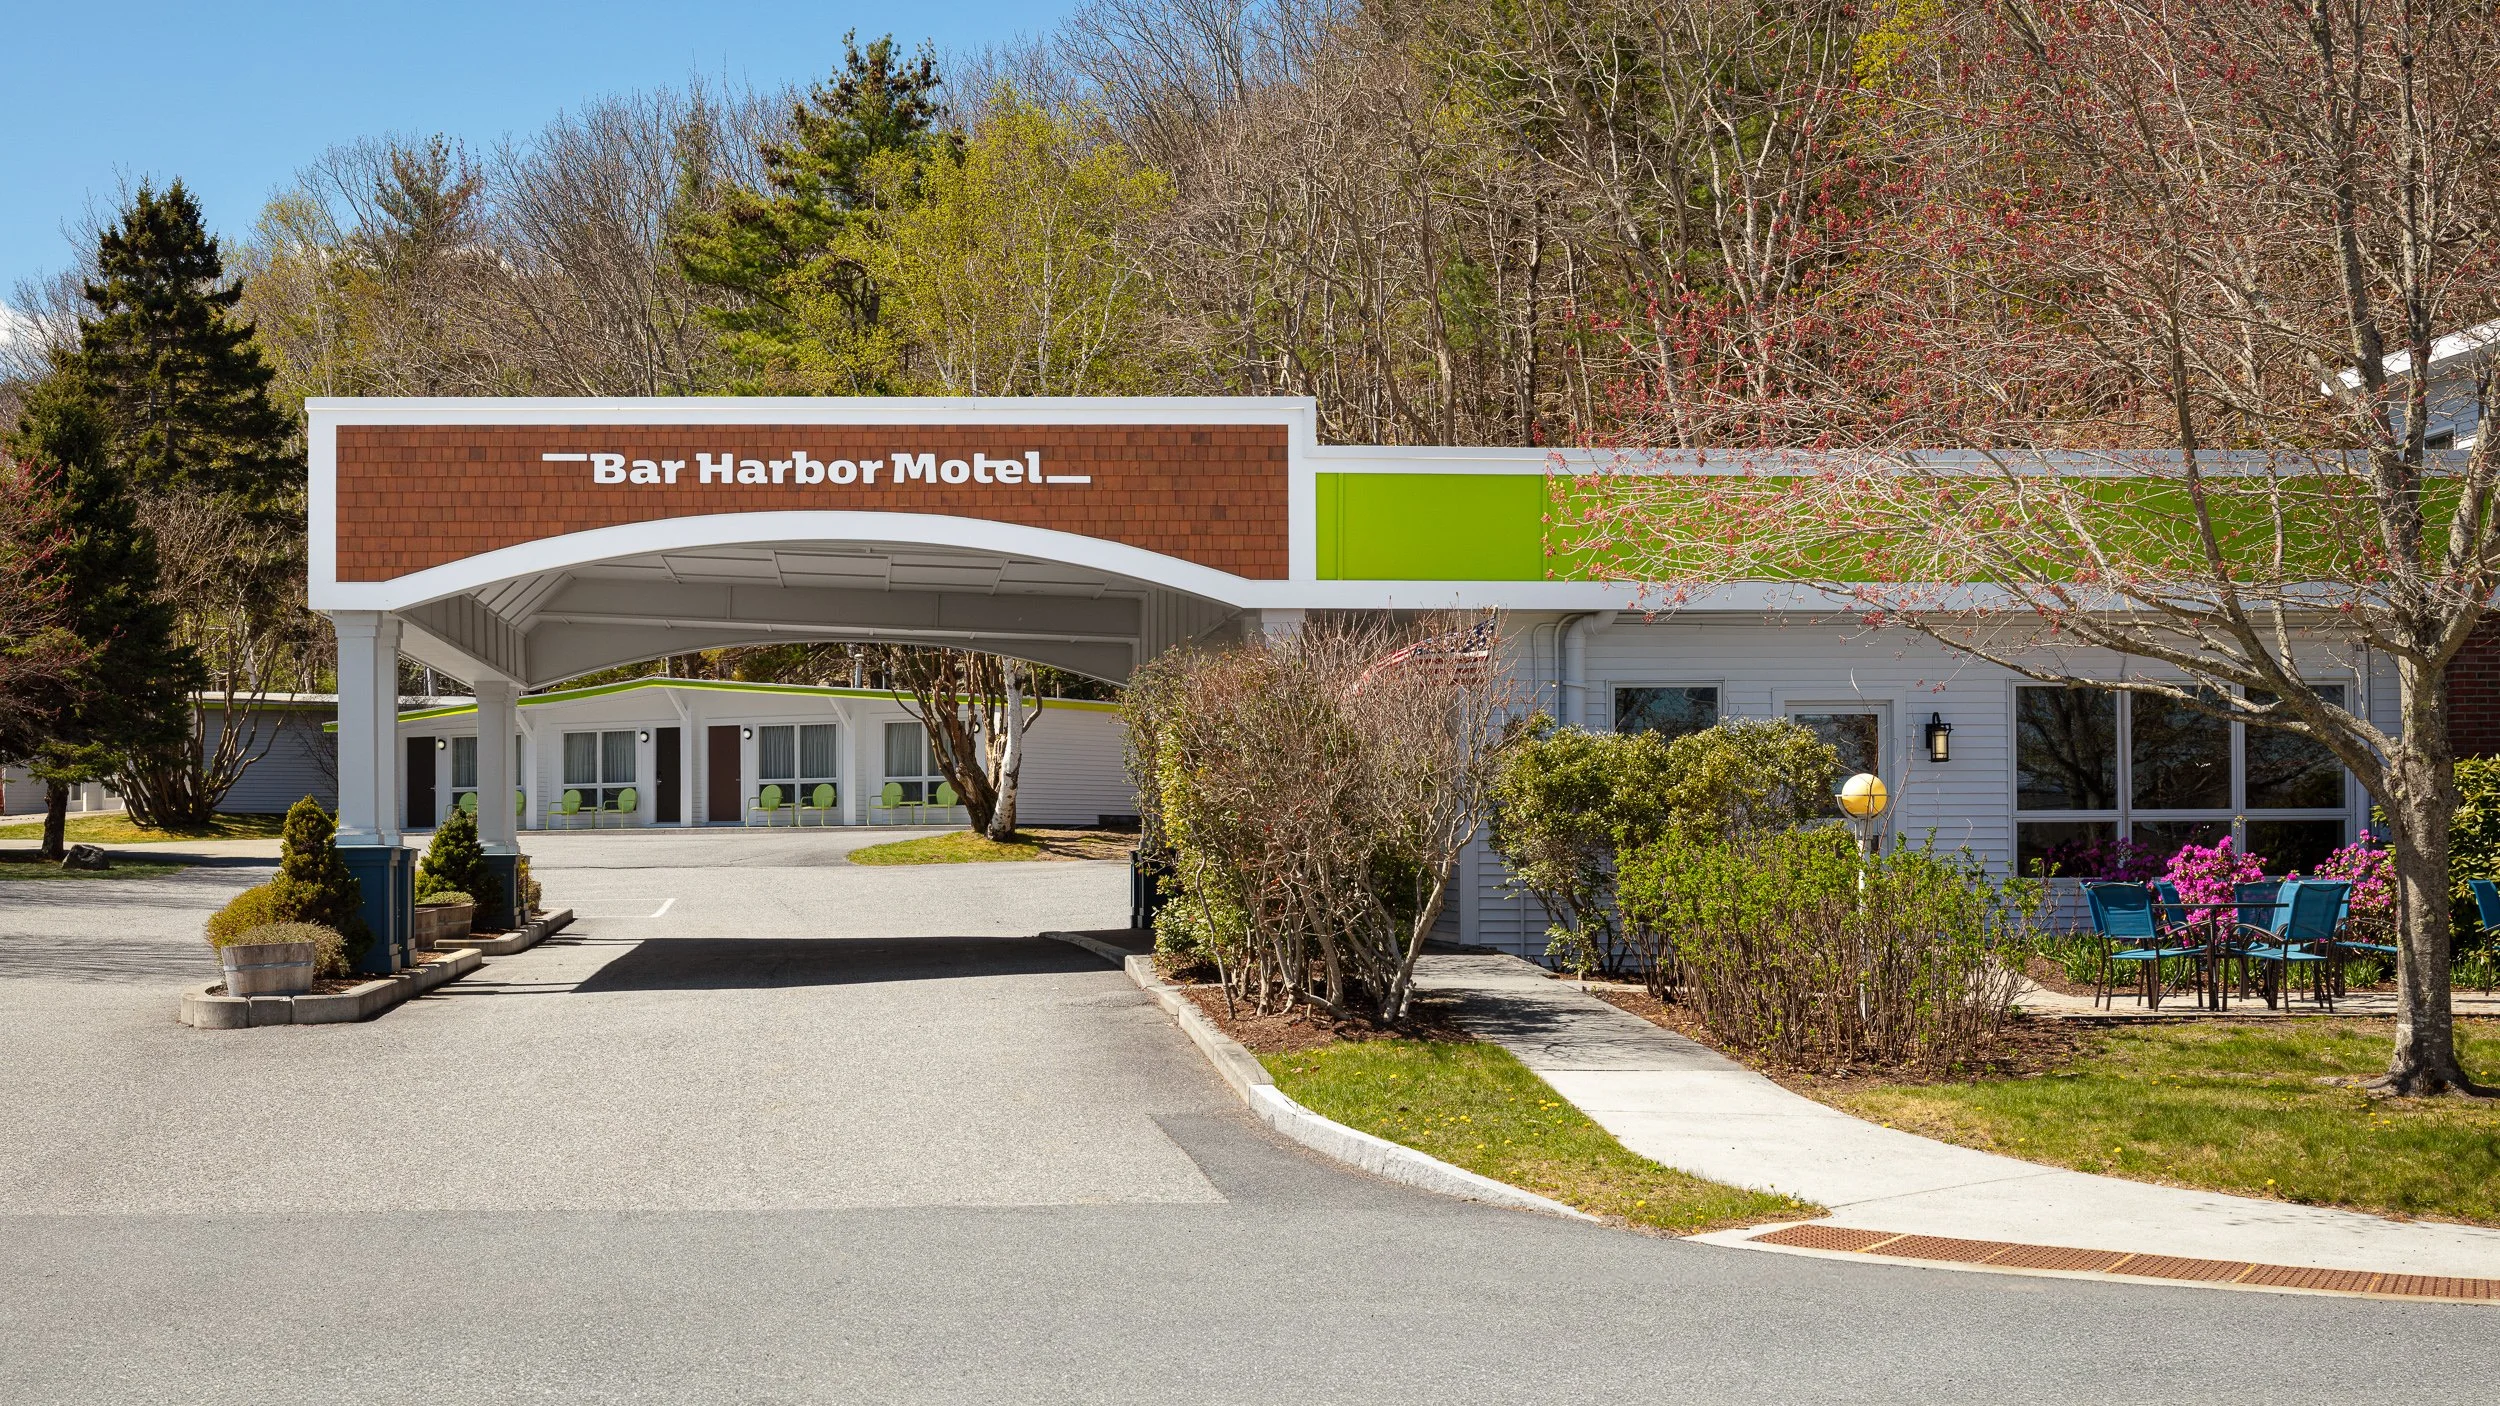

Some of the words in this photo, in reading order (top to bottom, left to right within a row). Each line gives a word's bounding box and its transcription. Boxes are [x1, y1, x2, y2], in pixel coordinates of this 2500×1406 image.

[590, 453, 685, 485] Bar
[696, 452, 884, 485] Harbor
[892, 452, 1043, 485] Motel
